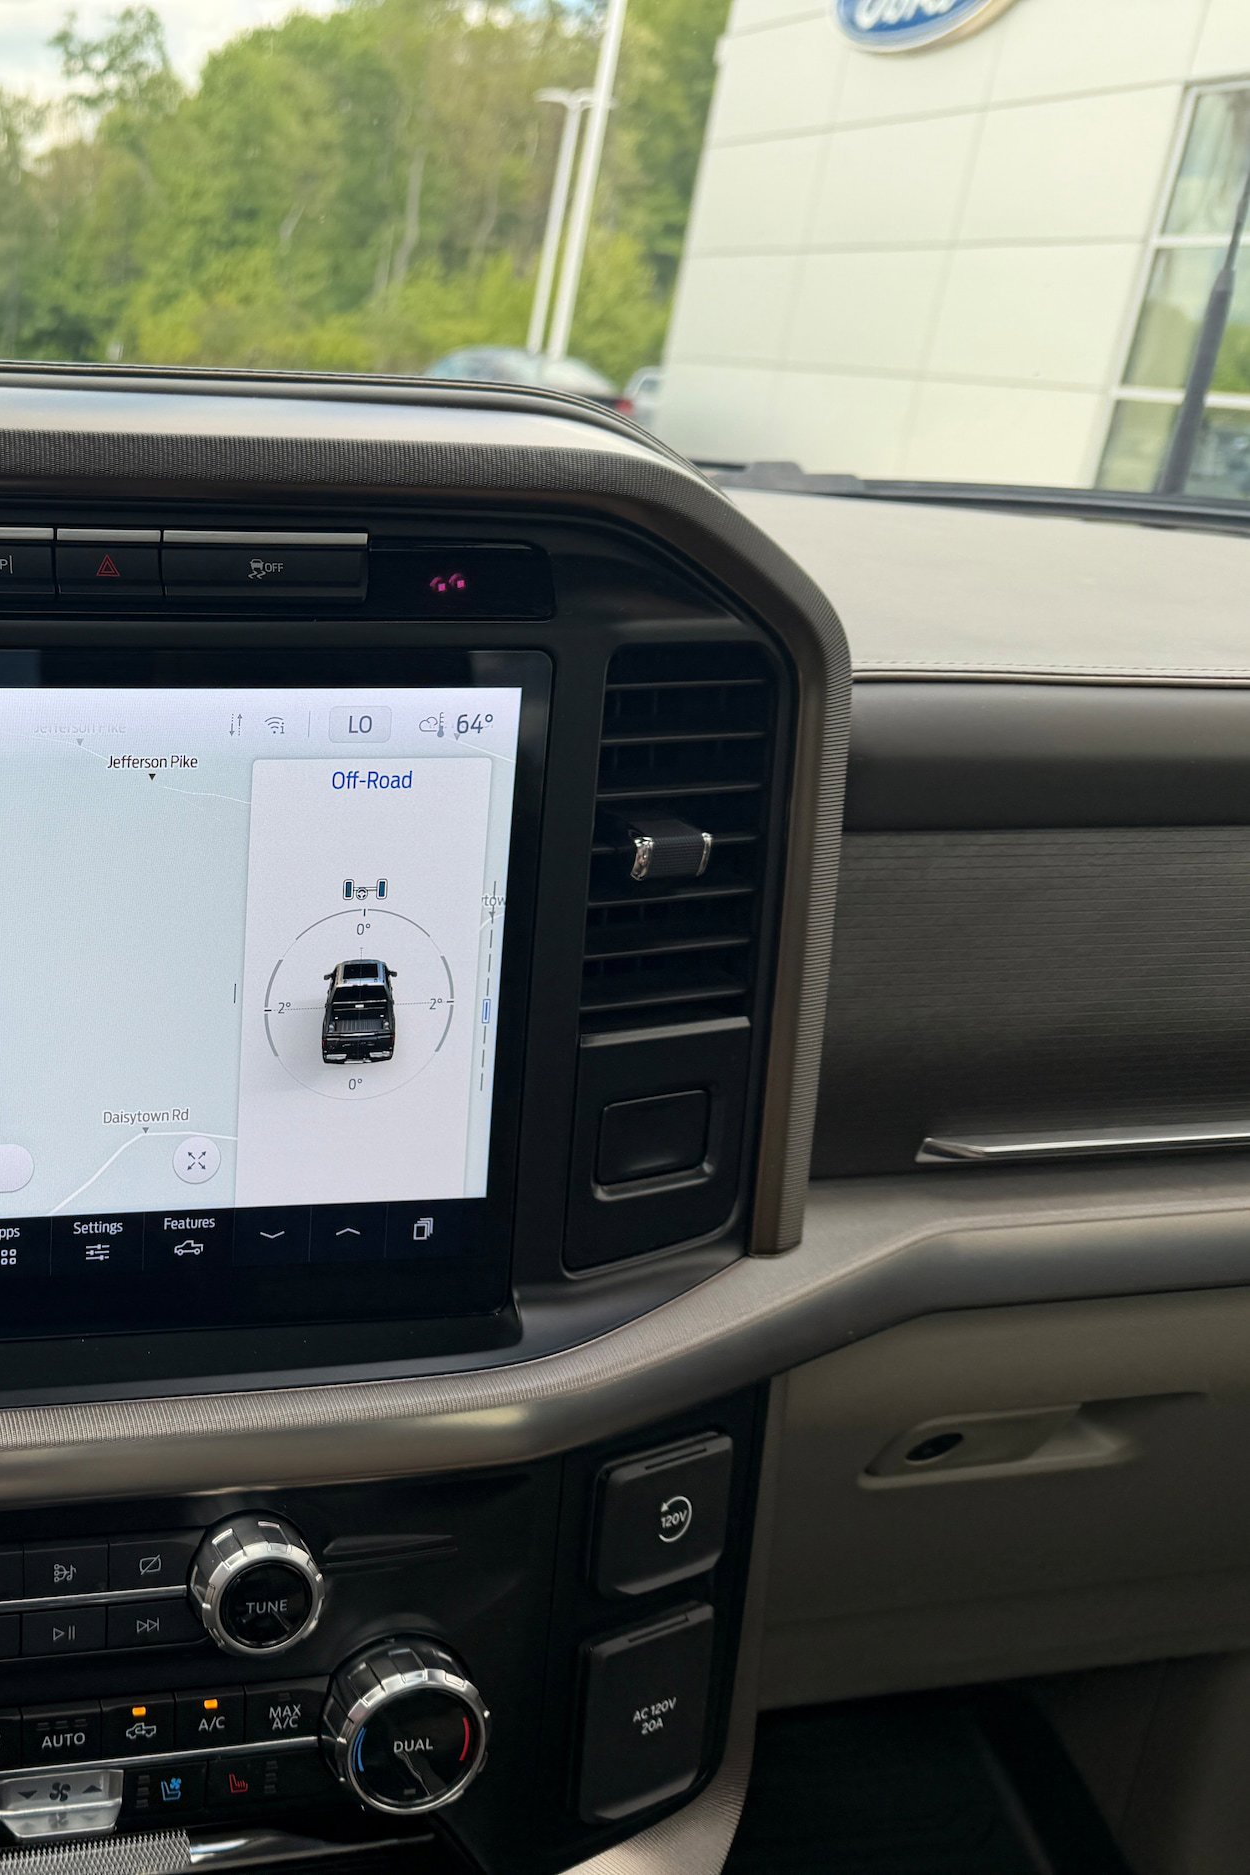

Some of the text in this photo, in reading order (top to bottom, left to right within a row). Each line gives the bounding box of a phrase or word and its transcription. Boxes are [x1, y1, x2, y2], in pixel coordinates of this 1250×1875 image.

[264, 562, 284, 573] OFF
[348, 716, 372, 734] LO
[456, 713, 494, 734] 64°
[107, 755, 198, 769] Jefferson Pike
[331, 770, 413, 790] Off-Road
[103, 1108, 189, 1128] Daisytown Rd
[73, 1219, 123, 1237] Settings
[163, 1215, 216, 1231] Features
[660, 1509, 688, 1529] 120V
[246, 1599, 288, 1614] TUNE
[269, 1703, 302, 1720] MAX
[632, 1696, 678, 1724] AC 120V
[198, 1715, 226, 1732] A/C
[272, 1714, 299, 1730] A/C
[640, 1716, 665, 1735] 20A
[41, 1732, 86, 1749] AUTO
[393, 1737, 433, 1752] DUAL
